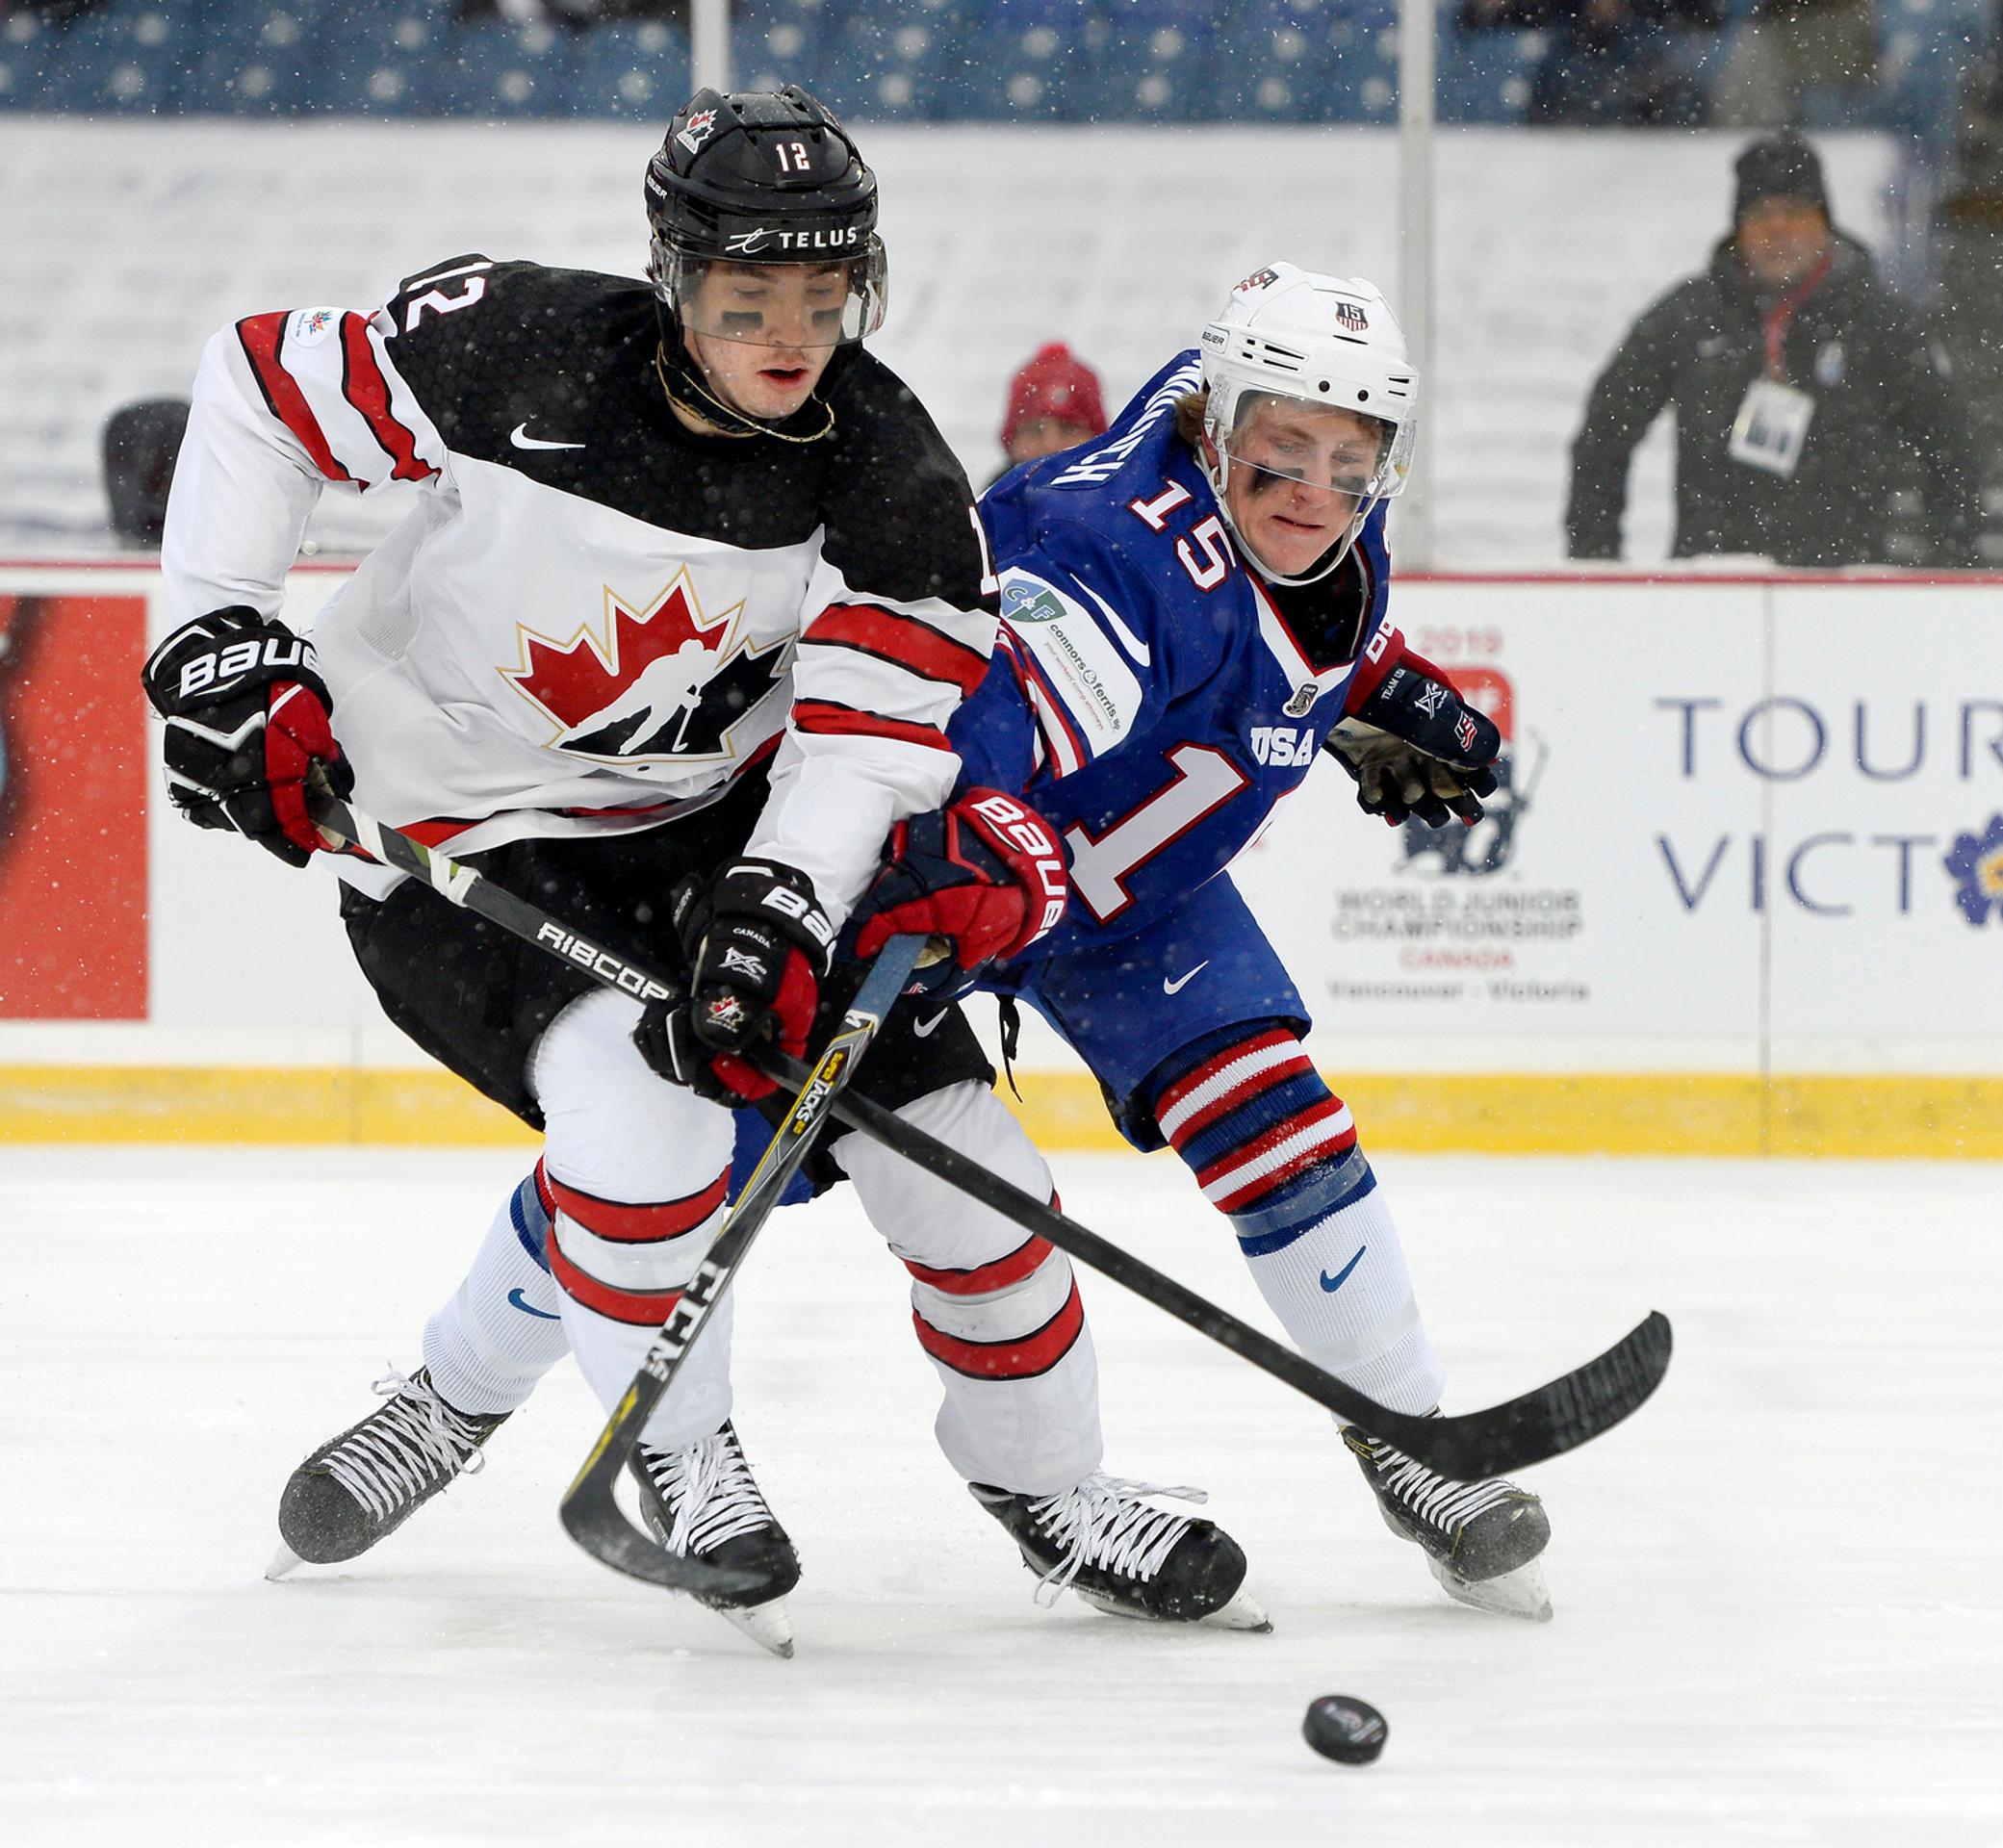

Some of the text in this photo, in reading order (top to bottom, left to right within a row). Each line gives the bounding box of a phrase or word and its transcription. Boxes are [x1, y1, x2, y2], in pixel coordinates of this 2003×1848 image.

[776, 141, 811, 173] 12
[778, 225, 858, 250] TELUS
[1342, 304, 1363, 321] 15
[1128, 477, 1237, 593] 15
[1049, 624, 1087, 672] connors
[1380, 679, 1400, 701] TEAM
[1250, 726, 1315, 767] USA
[1653, 695, 2003, 783] TOUR
[732, 927, 771, 949] CANADA
[795, 1077, 831, 1122] TACKS
[646, 1260, 731, 1383] CCM
